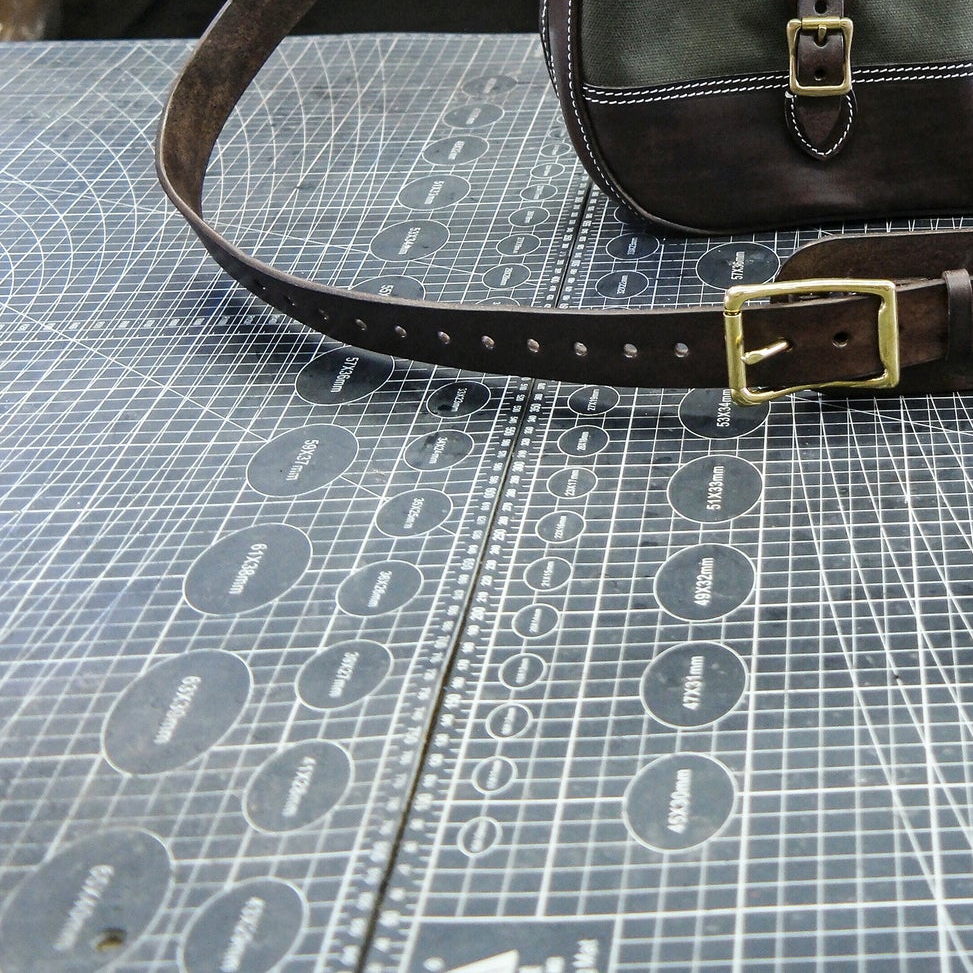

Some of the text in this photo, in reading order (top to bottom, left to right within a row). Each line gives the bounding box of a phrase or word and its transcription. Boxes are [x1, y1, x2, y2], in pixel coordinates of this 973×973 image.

[398, 227, 421, 255] 53X34mm
[730, 251, 746, 281] 57X36mm
[330, 356, 359, 393] 57X36mm
[715, 388, 733, 428] 53X34mm
[285, 439, 319, 481] 59X37mm
[705, 465, 725, 511] 51X33mm
[402, 497, 425, 529] 35X25mm
[228, 543, 268, 595] 61X38mm
[693, 557, 715, 606] 49X32mm
[681, 655, 705, 711] 47X31mm
